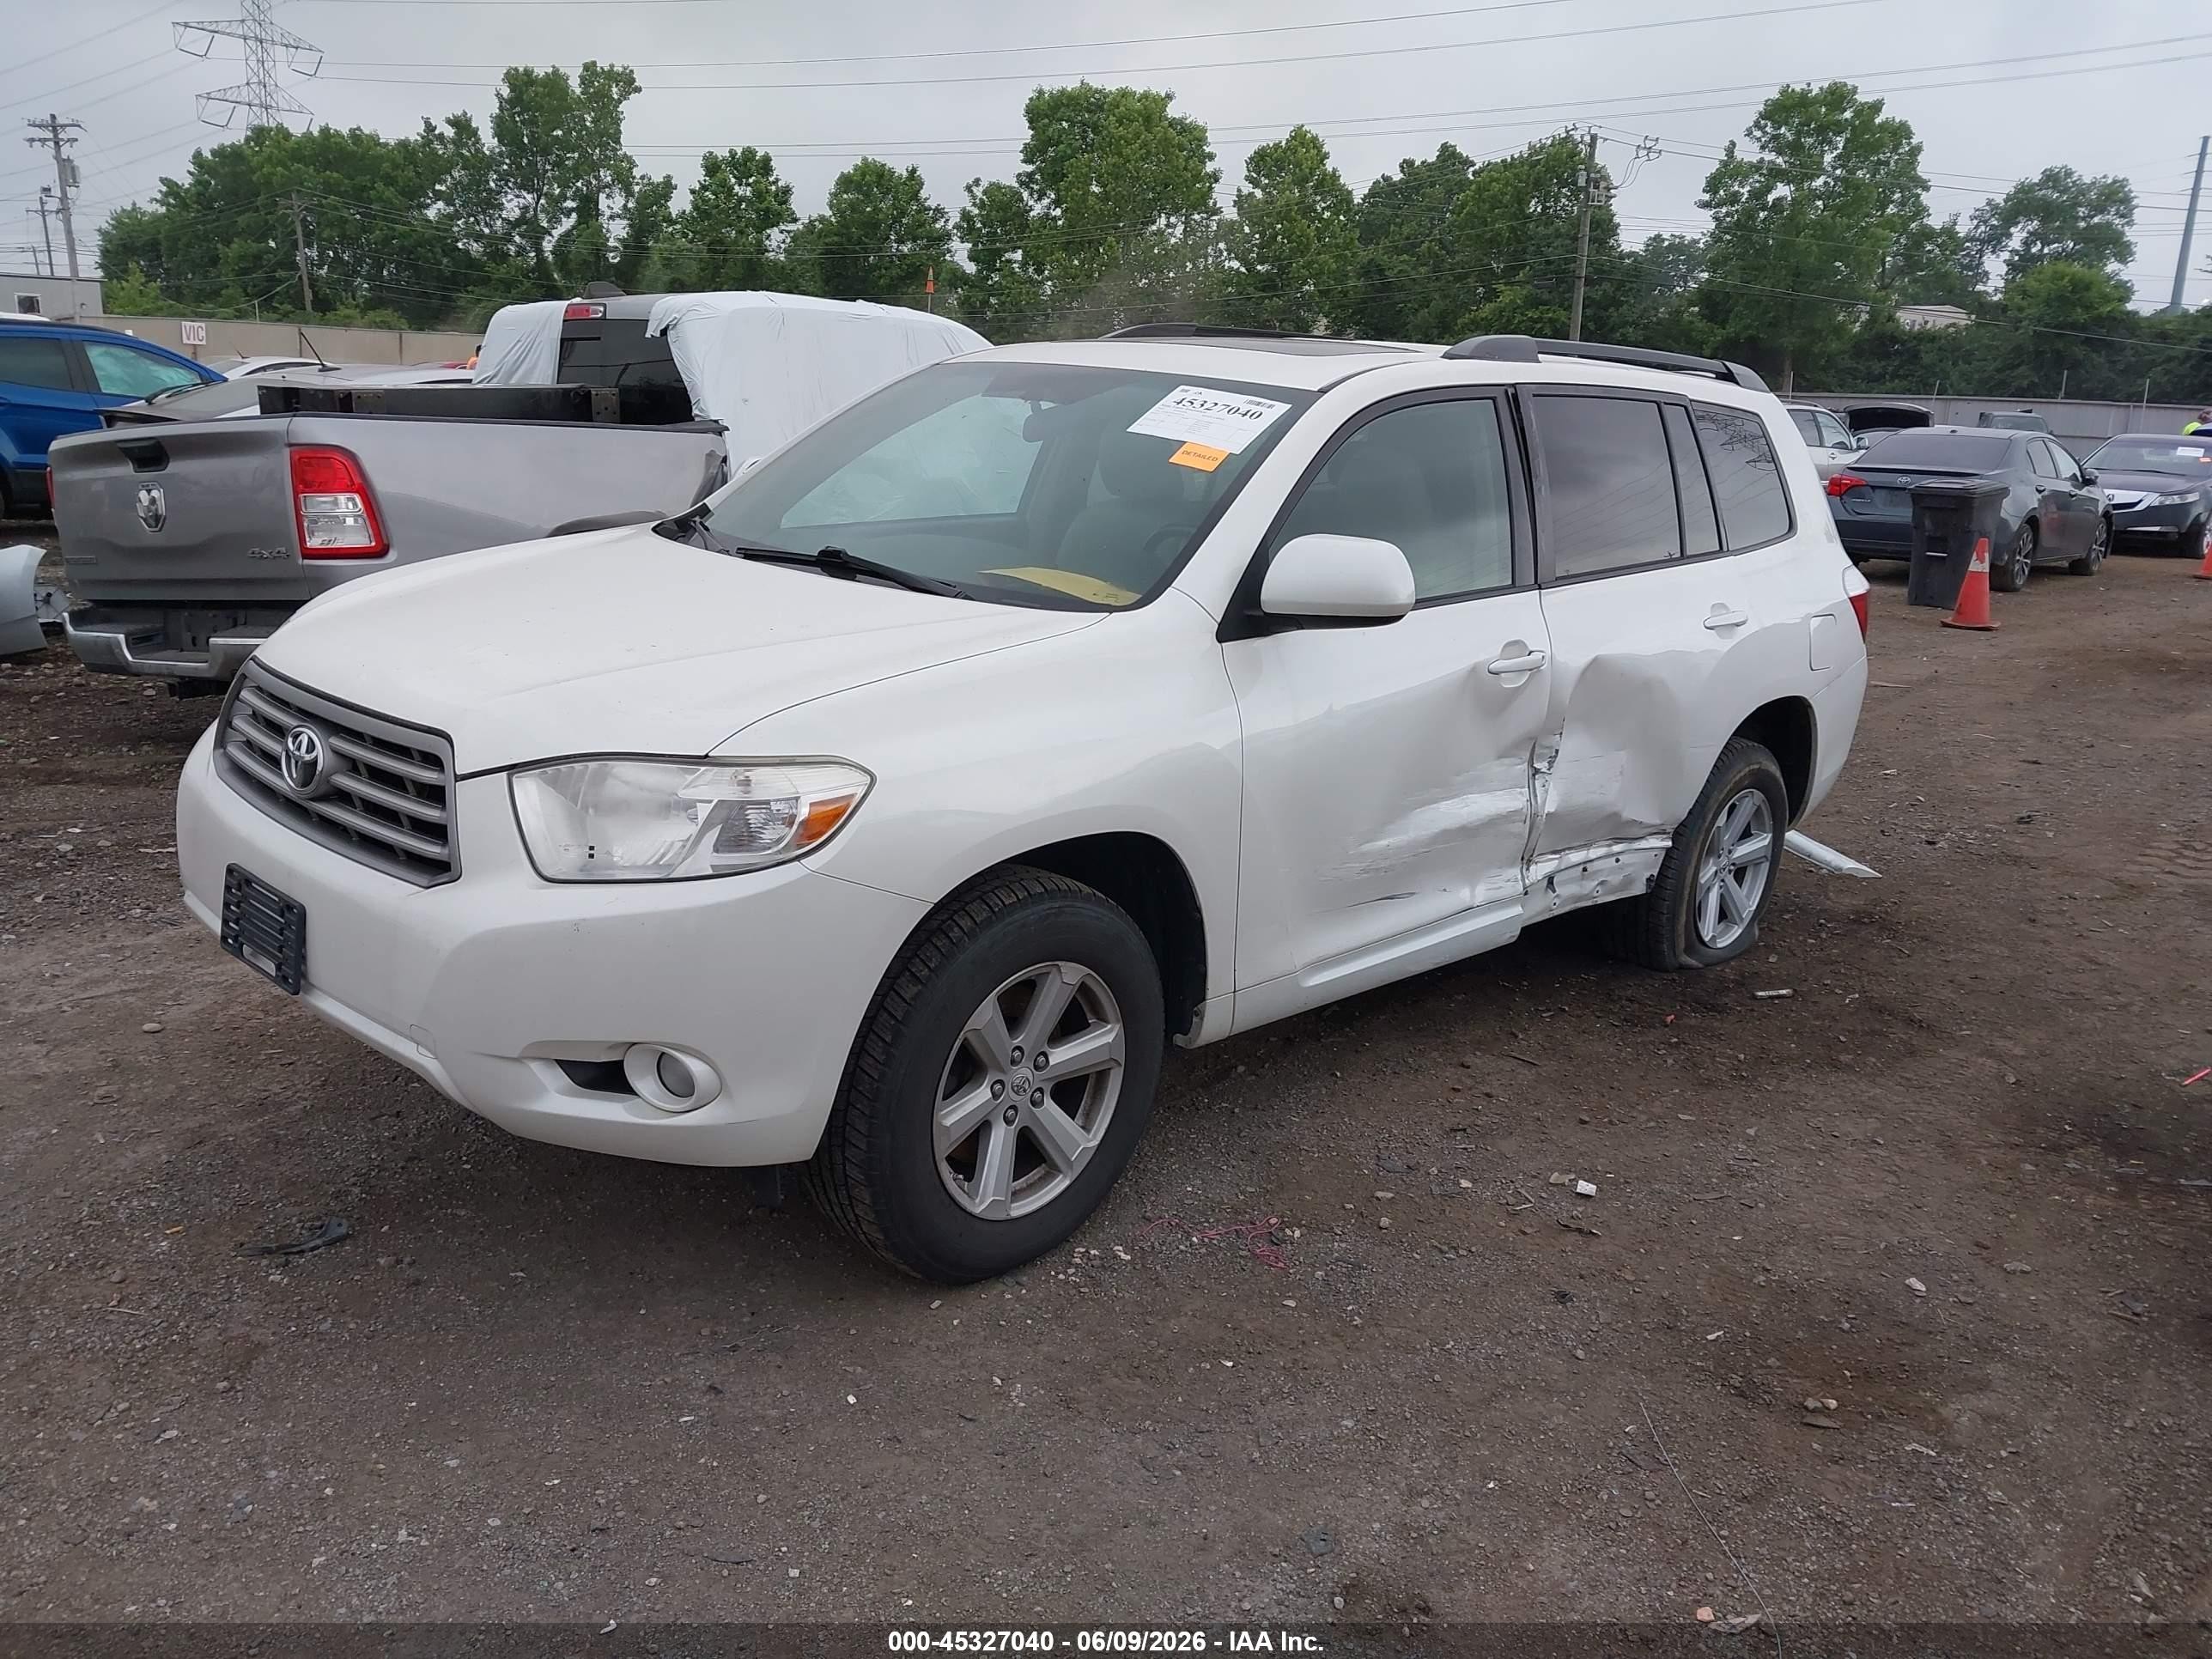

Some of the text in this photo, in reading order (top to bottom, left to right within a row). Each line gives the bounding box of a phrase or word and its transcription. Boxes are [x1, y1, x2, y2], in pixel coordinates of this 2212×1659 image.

[184, 325, 204, 342] VIC
[1173, 397, 1264, 420] 45327040
[1182, 450, 1218, 462] DETAILED
